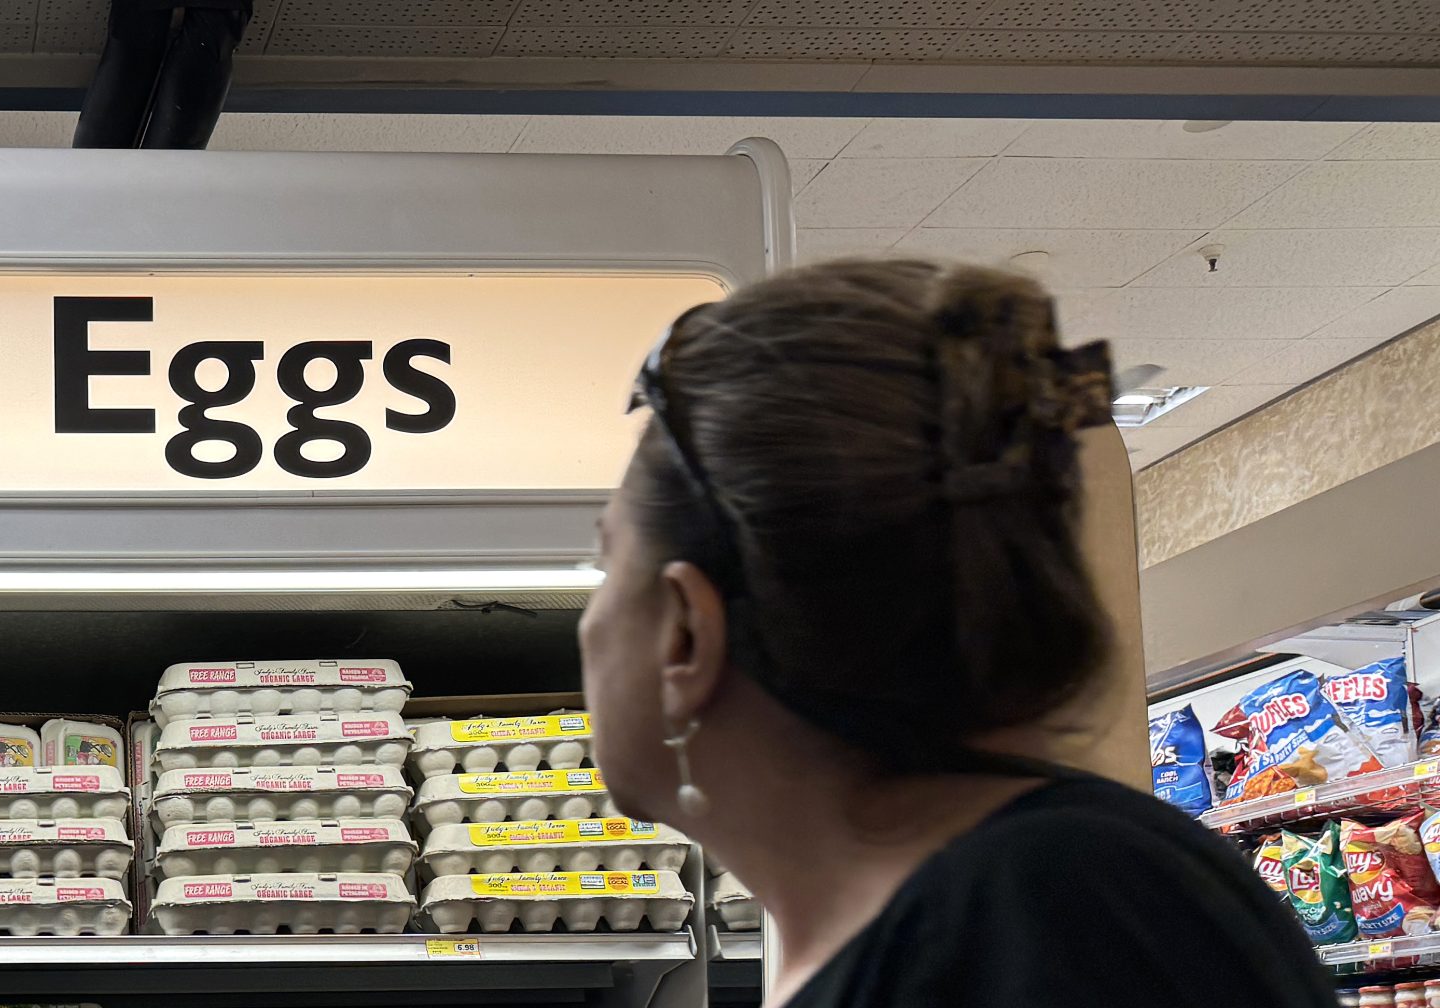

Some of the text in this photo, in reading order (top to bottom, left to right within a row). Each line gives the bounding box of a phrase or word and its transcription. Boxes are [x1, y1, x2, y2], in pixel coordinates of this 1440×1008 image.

[53, 296, 456, 478] Eggs
[190, 669, 235, 680] FREE RANGE
[260, 674, 314, 683] ORGANIC LARGE
[190, 726, 236, 738] FREE RANGE
[261, 730, 316, 739] ORGANIC LARGE
[185, 884, 231, 895] FREE RANGE
[256, 889, 313, 898] ORGANIC LARGE
